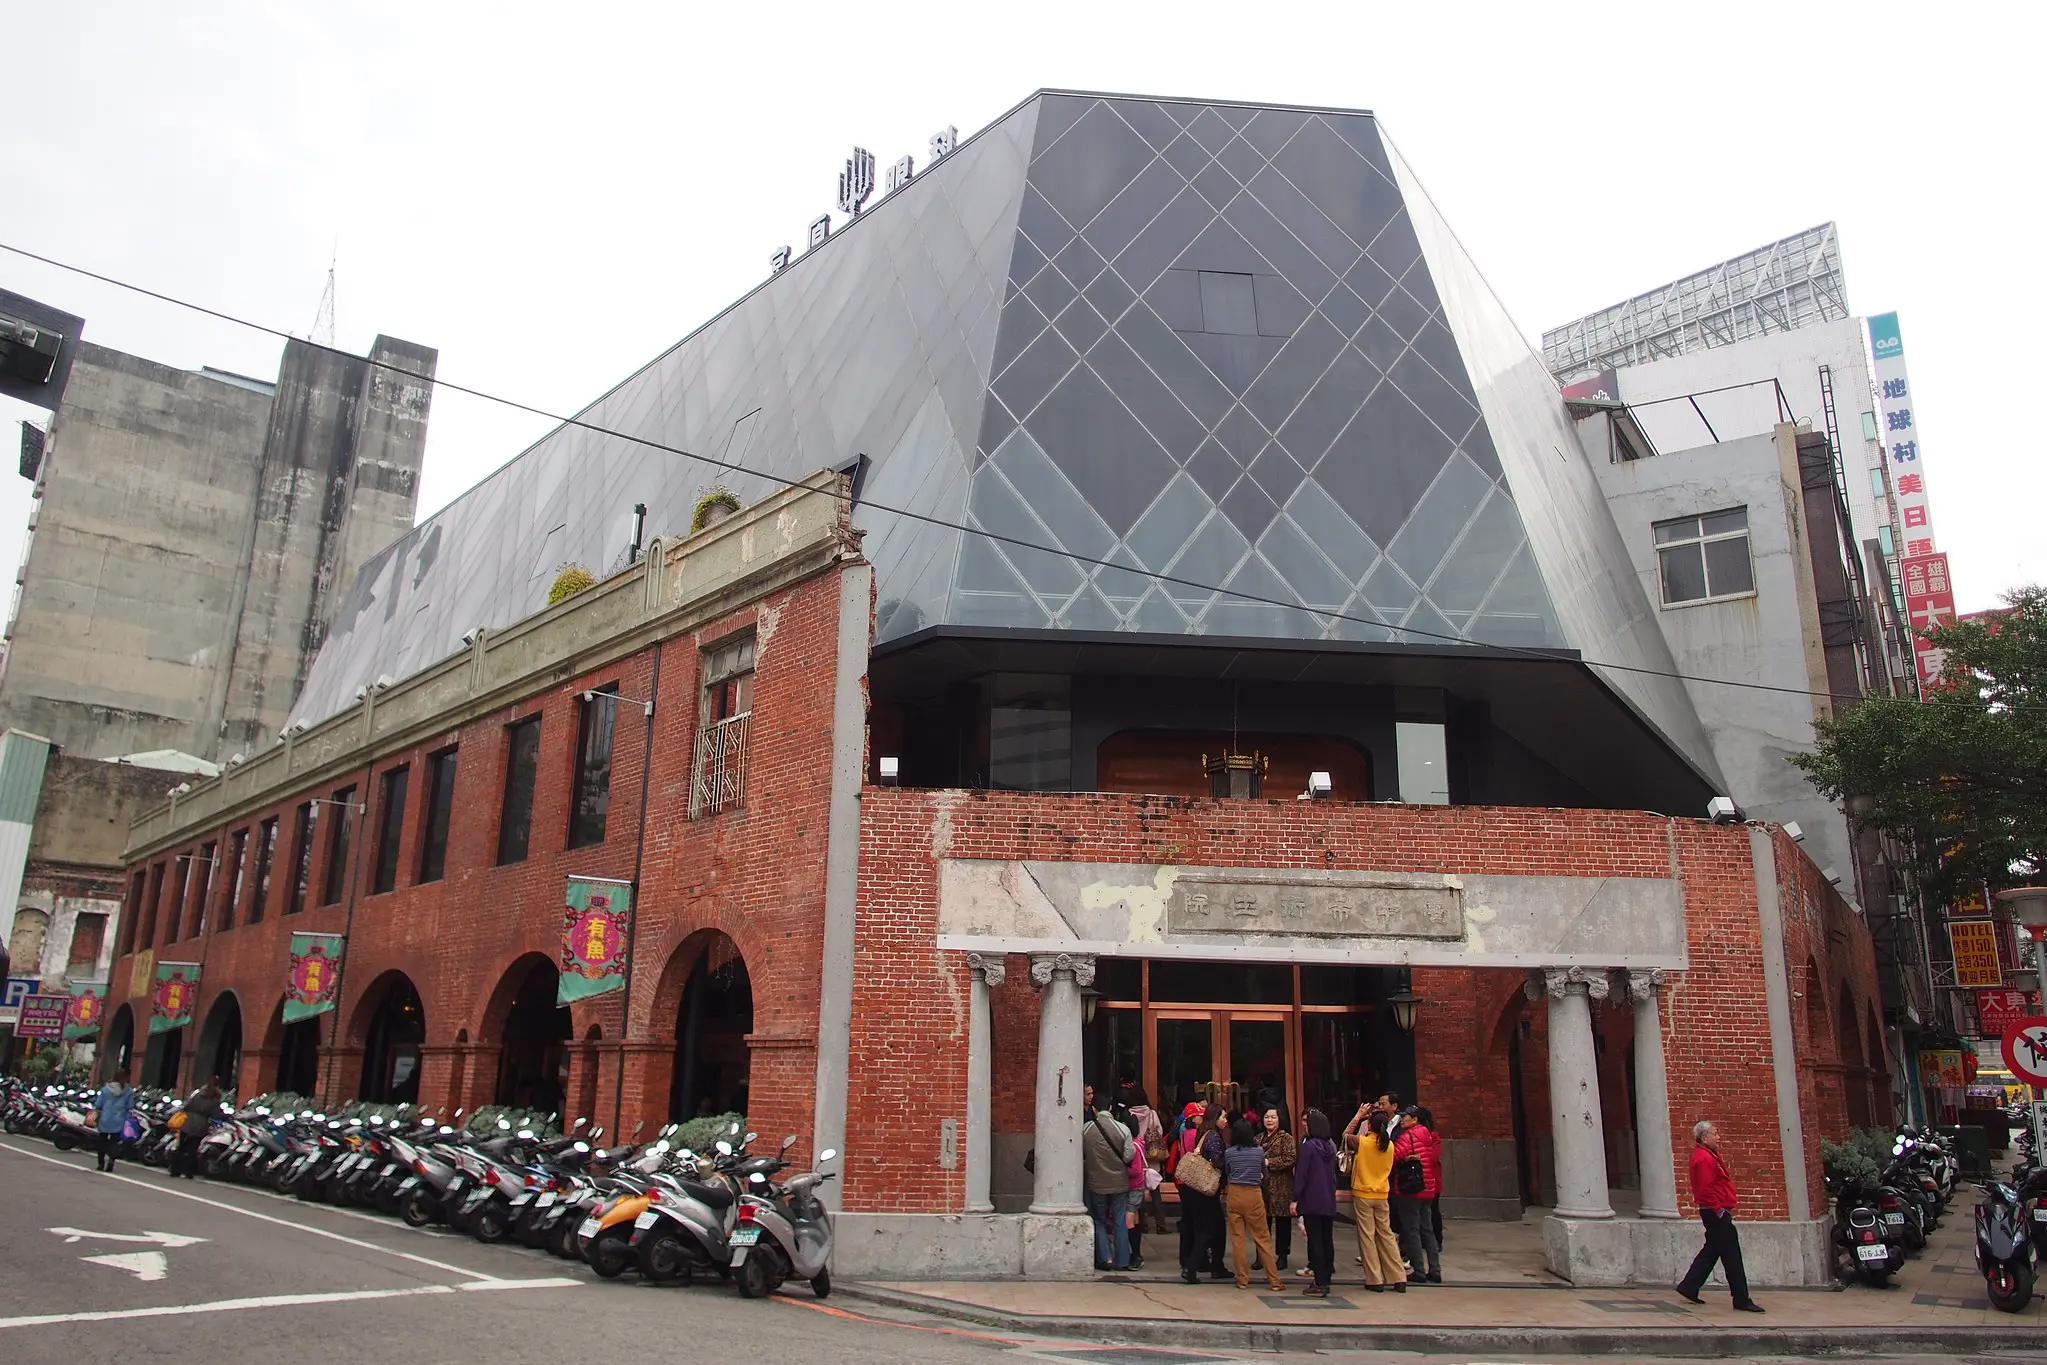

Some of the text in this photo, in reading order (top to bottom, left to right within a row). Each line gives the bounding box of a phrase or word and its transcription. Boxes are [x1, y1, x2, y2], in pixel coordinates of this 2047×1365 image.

[1882, 377, 1934, 556] 地球村美日語
[1951, 924, 1993, 936] HOTEL
